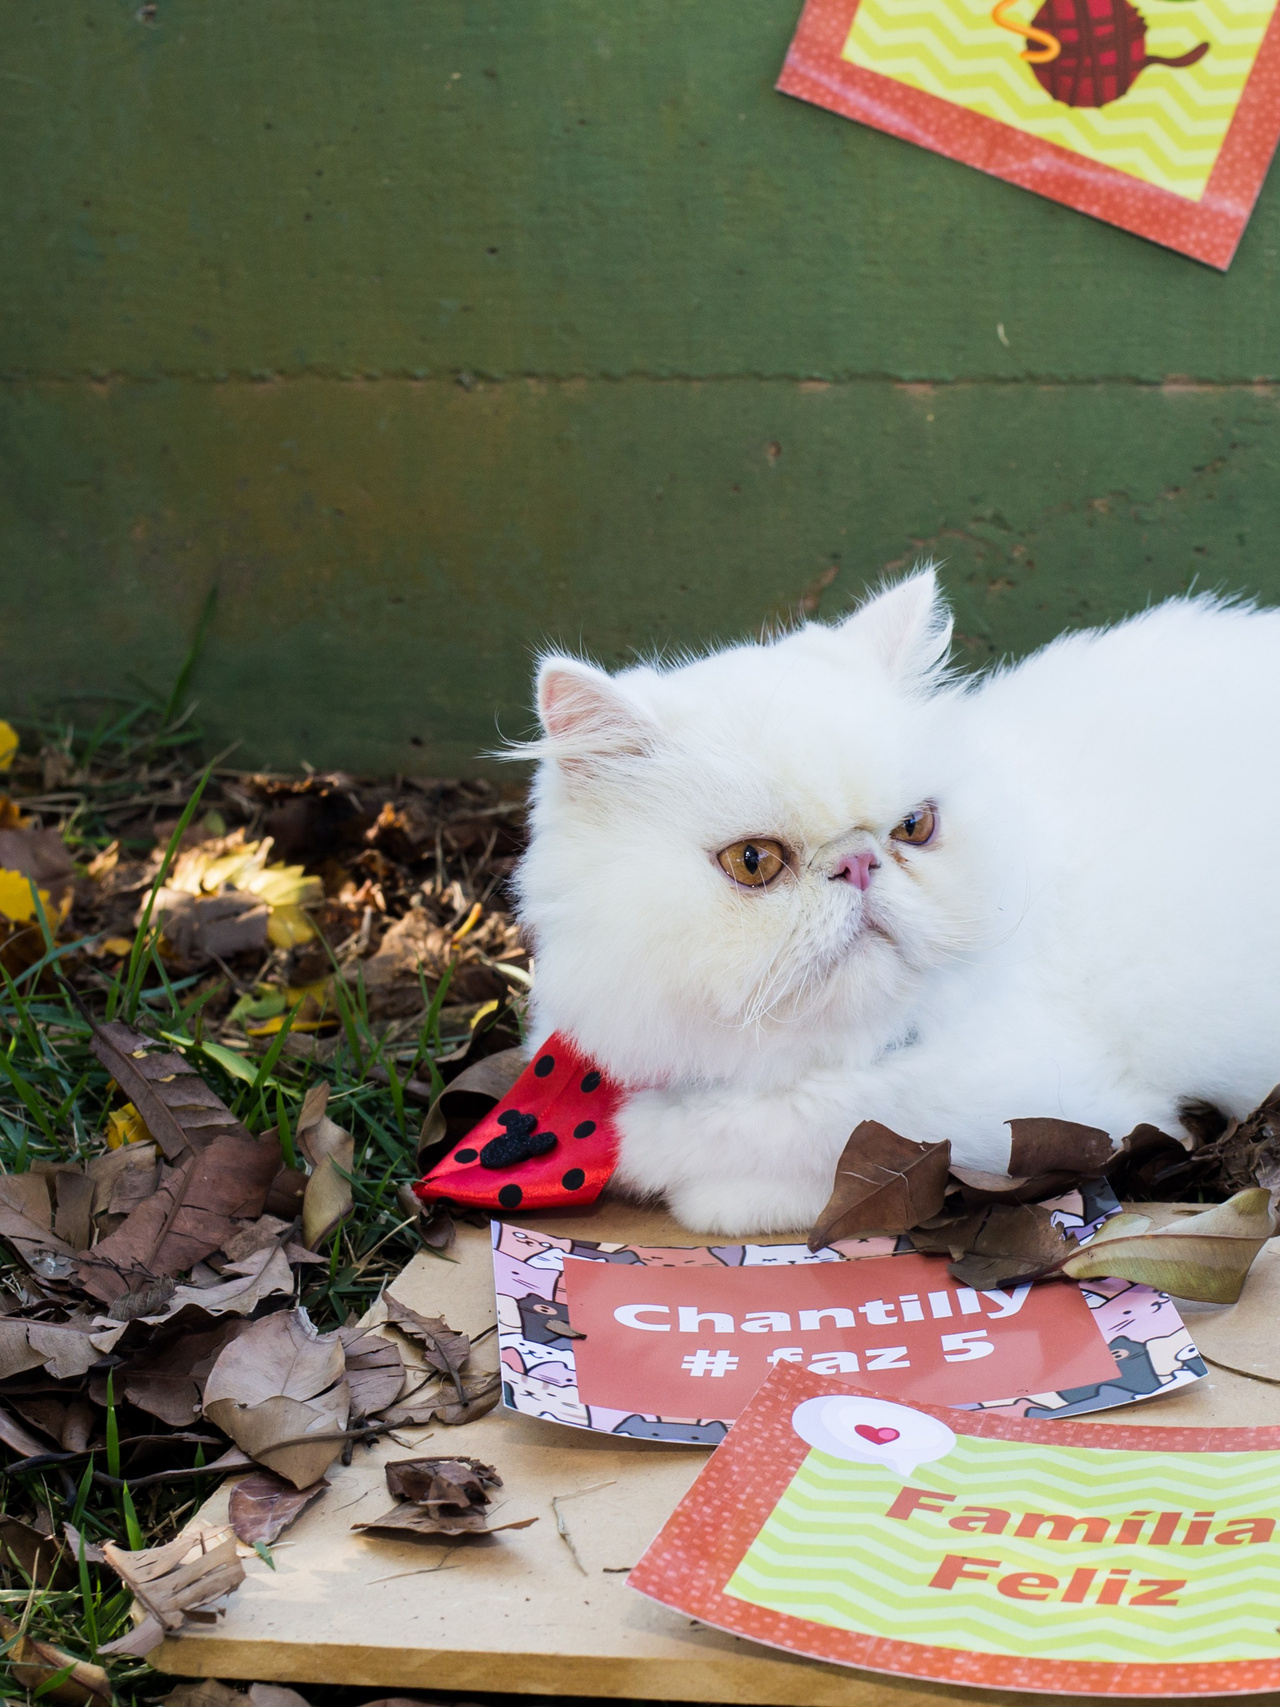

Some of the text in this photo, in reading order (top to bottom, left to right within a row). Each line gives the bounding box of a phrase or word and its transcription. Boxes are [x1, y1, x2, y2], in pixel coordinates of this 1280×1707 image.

[612, 1281, 1035, 1333] Chantilly
[681, 1349, 739, 1378] #
[940, 1329, 996, 1363] 5
[884, 1486, 1277, 1546] Família
[927, 1553, 1188, 1606] Feliz
